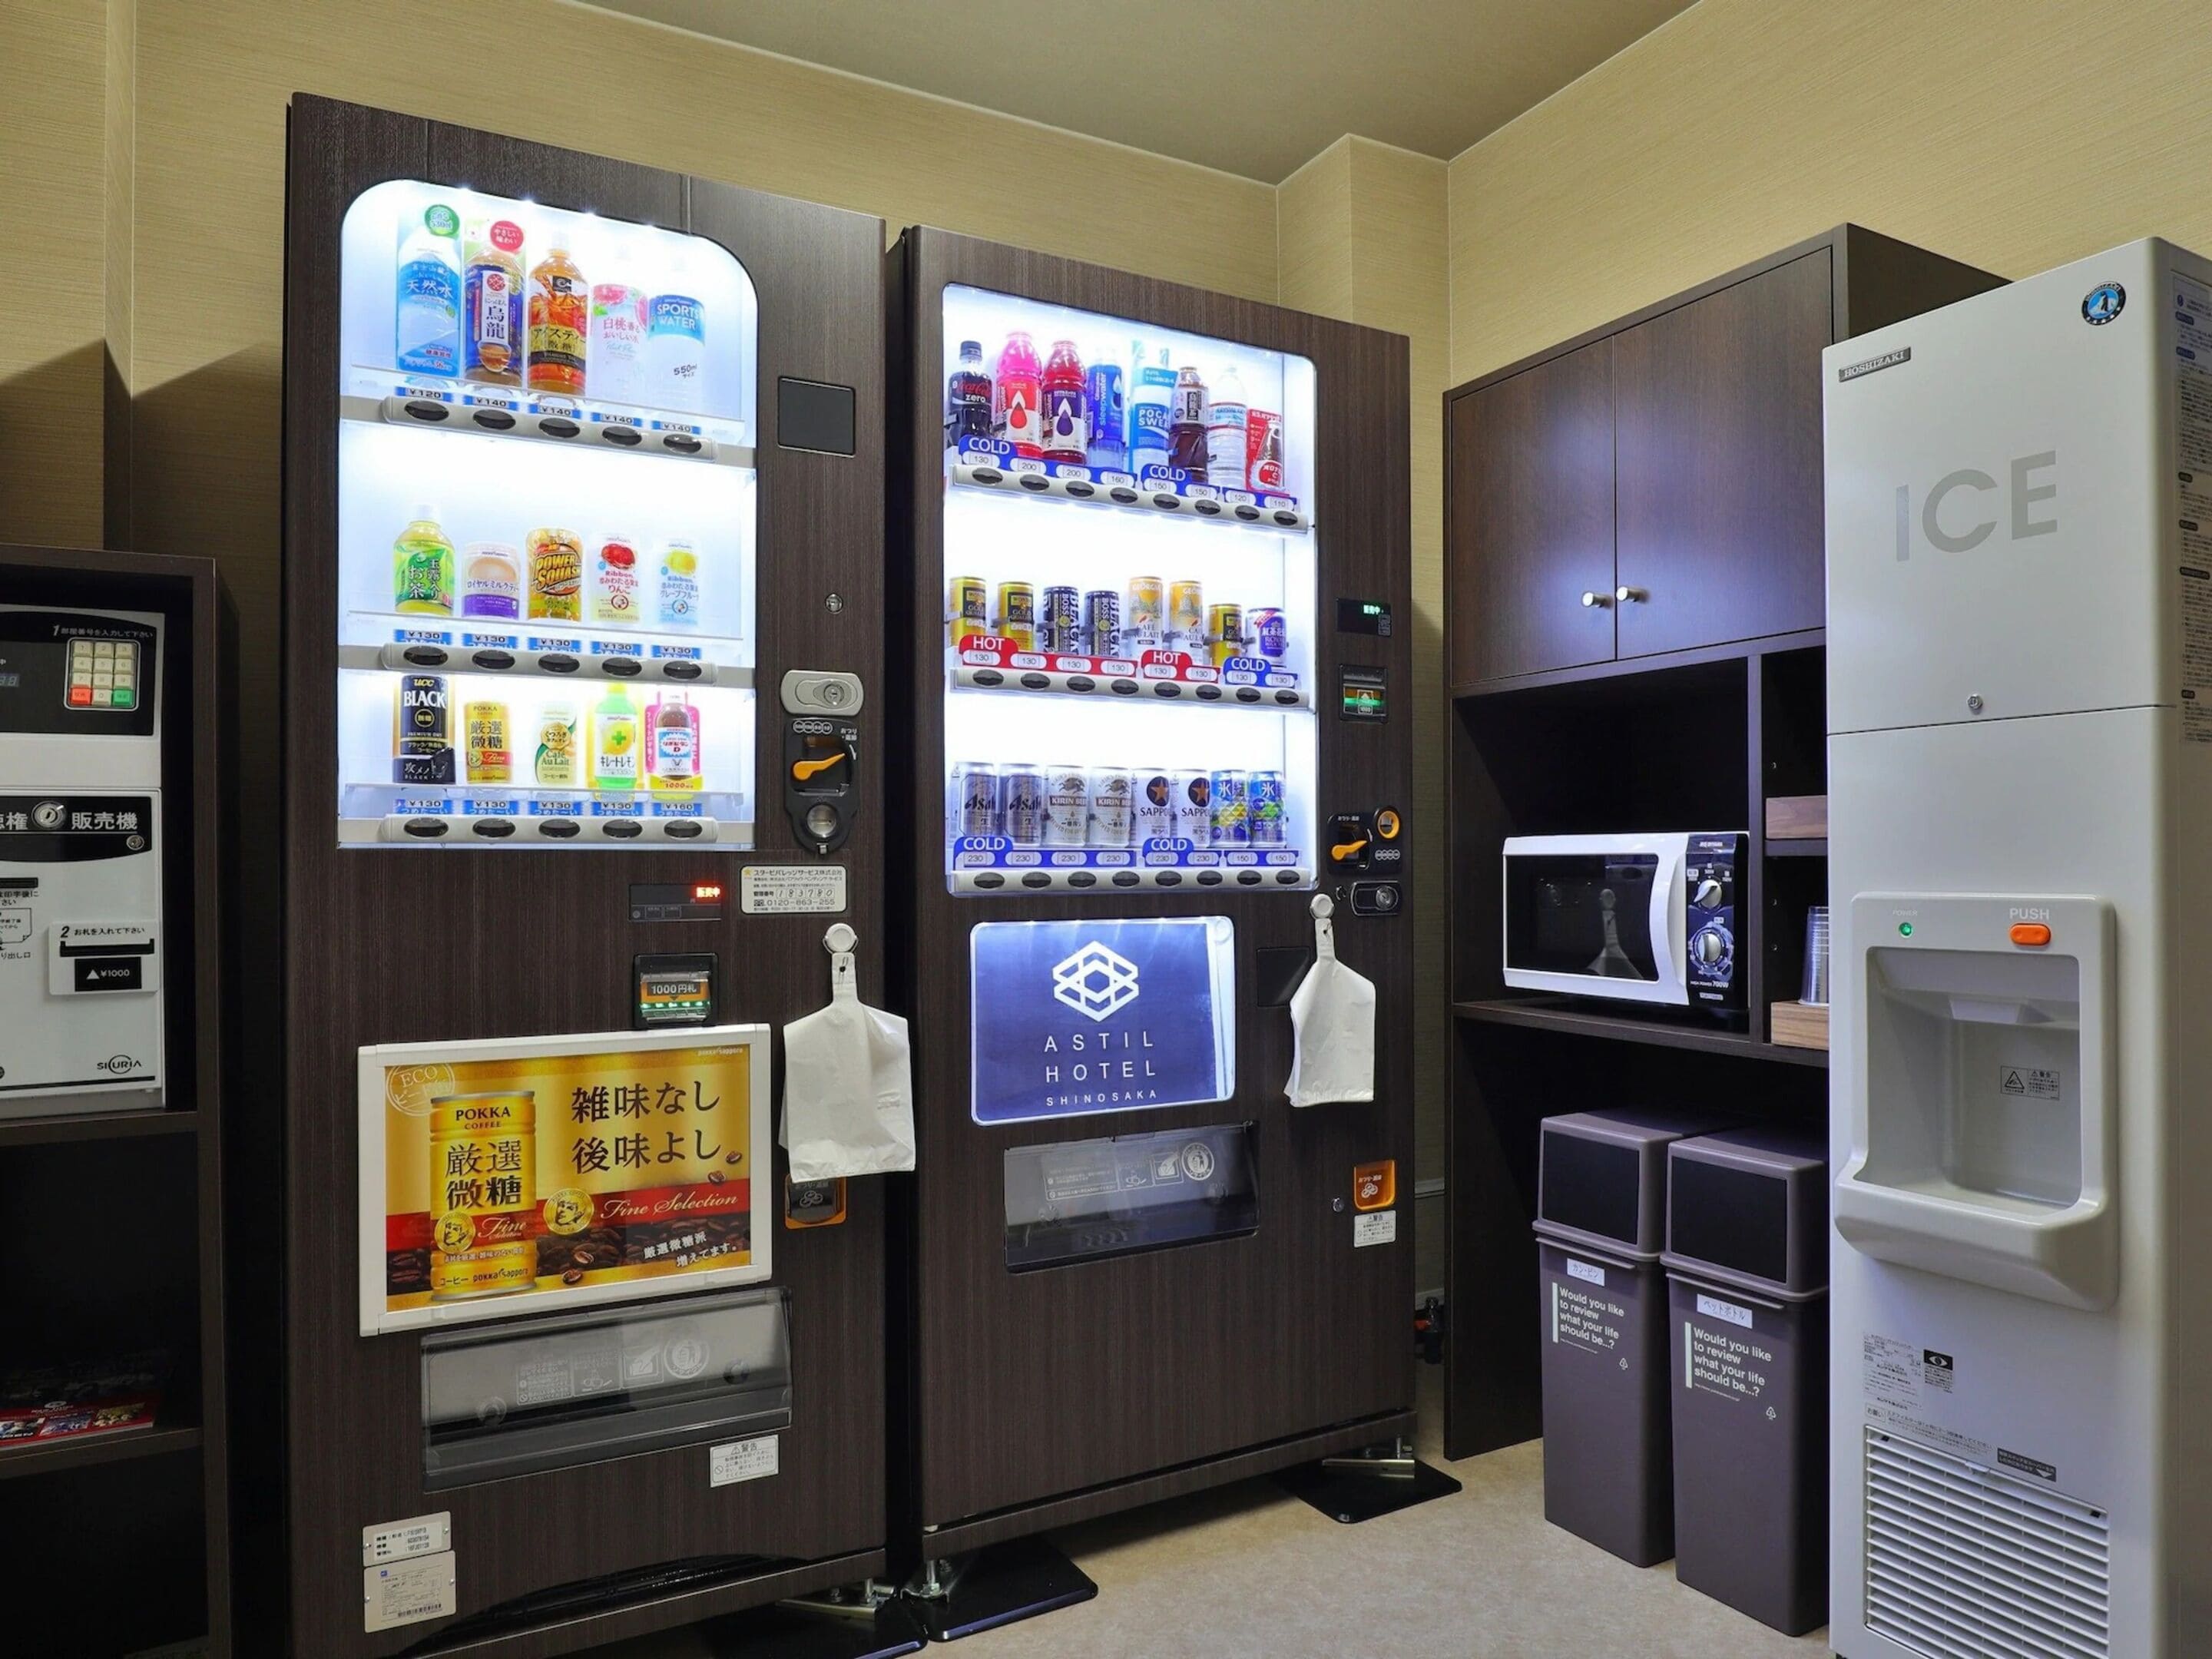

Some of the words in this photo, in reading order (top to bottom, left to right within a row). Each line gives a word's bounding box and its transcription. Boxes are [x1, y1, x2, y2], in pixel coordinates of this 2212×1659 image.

[406, 280, 454, 300] 天然水
[657, 303, 701, 320] SPORTS
[659, 316, 697, 330] WATER
[1844, 350, 1905, 379] HOSHIZAKI
[965, 393, 986, 403] zero
[969, 437, 1011, 455] COLD
[1022, 462, 1037, 471] 200
[1149, 465, 1186, 481] COLD
[1896, 450, 2058, 562] ICE
[537, 554, 575, 571] POWER
[53, 624, 61, 637] 1
[973, 637, 1005, 651] HOT
[1153, 651, 1181, 664] HOT
[1231, 658, 1265, 671] COLD
[403, 690, 446, 708] BLACK
[470, 720, 503, 736] 厳選
[470, 735, 504, 750] 微糖
[1051, 796, 1074, 806] KIRIN
[1098, 798, 1119, 806] KIRIN
[71, 812, 138, 830] 販売機
[964, 837, 1005, 850] COLD
[1151, 839, 1187, 851] COLD
[2009, 908, 2050, 920] PUSH
[61, 926, 70, 939] 2
[75, 926, 145, 936] お札を入れて下さい
[651, 982, 697, 995] 1000円札
[1045, 1031, 1154, 1052] ASTIL
[399, 1065, 438, 1088] ECO
[1046, 1061, 1156, 1083] HOTEL
[571, 1081, 720, 1124] 雑味なし
[1047, 1089, 1157, 1106] SHINOSAKA
[455, 1106, 511, 1121] POKKA
[464, 1121, 502, 1131] COFFEE
[445, 1139, 522, 1177] 厳選
[571, 1129, 721, 1174] 後味よし
[446, 1175, 522, 1211] 微糖
[601, 1199, 649, 1219] Fine
[654, 1190, 739, 1216] Selection
[644, 1230, 707, 1260] 厳選微糖派
[440, 1273, 469, 1286] コーヒー
[1559, 1286, 1588, 1305] Would
[1589, 1298, 1606, 1311] you
[1608, 1302, 1625, 1317] like
[1560, 1300, 1568, 1310] to
[1571, 1303, 1599, 1320] review
[1560, 1312, 1581, 1326] what
[1582, 1320, 1603, 1333] your
[1605, 1325, 1620, 1339] life
[1560, 1323, 1590, 1341] should
[1694, 1326, 1727, 1347] Would
[1729, 1339, 1750, 1353] you
[1752, 1346, 1773, 1362] like
[1694, 1341, 1704, 1353] to
[1707, 1346, 1742, 1365] review
[1694, 1355, 1719, 1371] what
[1720, 1363, 1746, 1378] your
[1748, 1368, 1766, 1386] life
[1694, 1366, 1730, 1387] should
